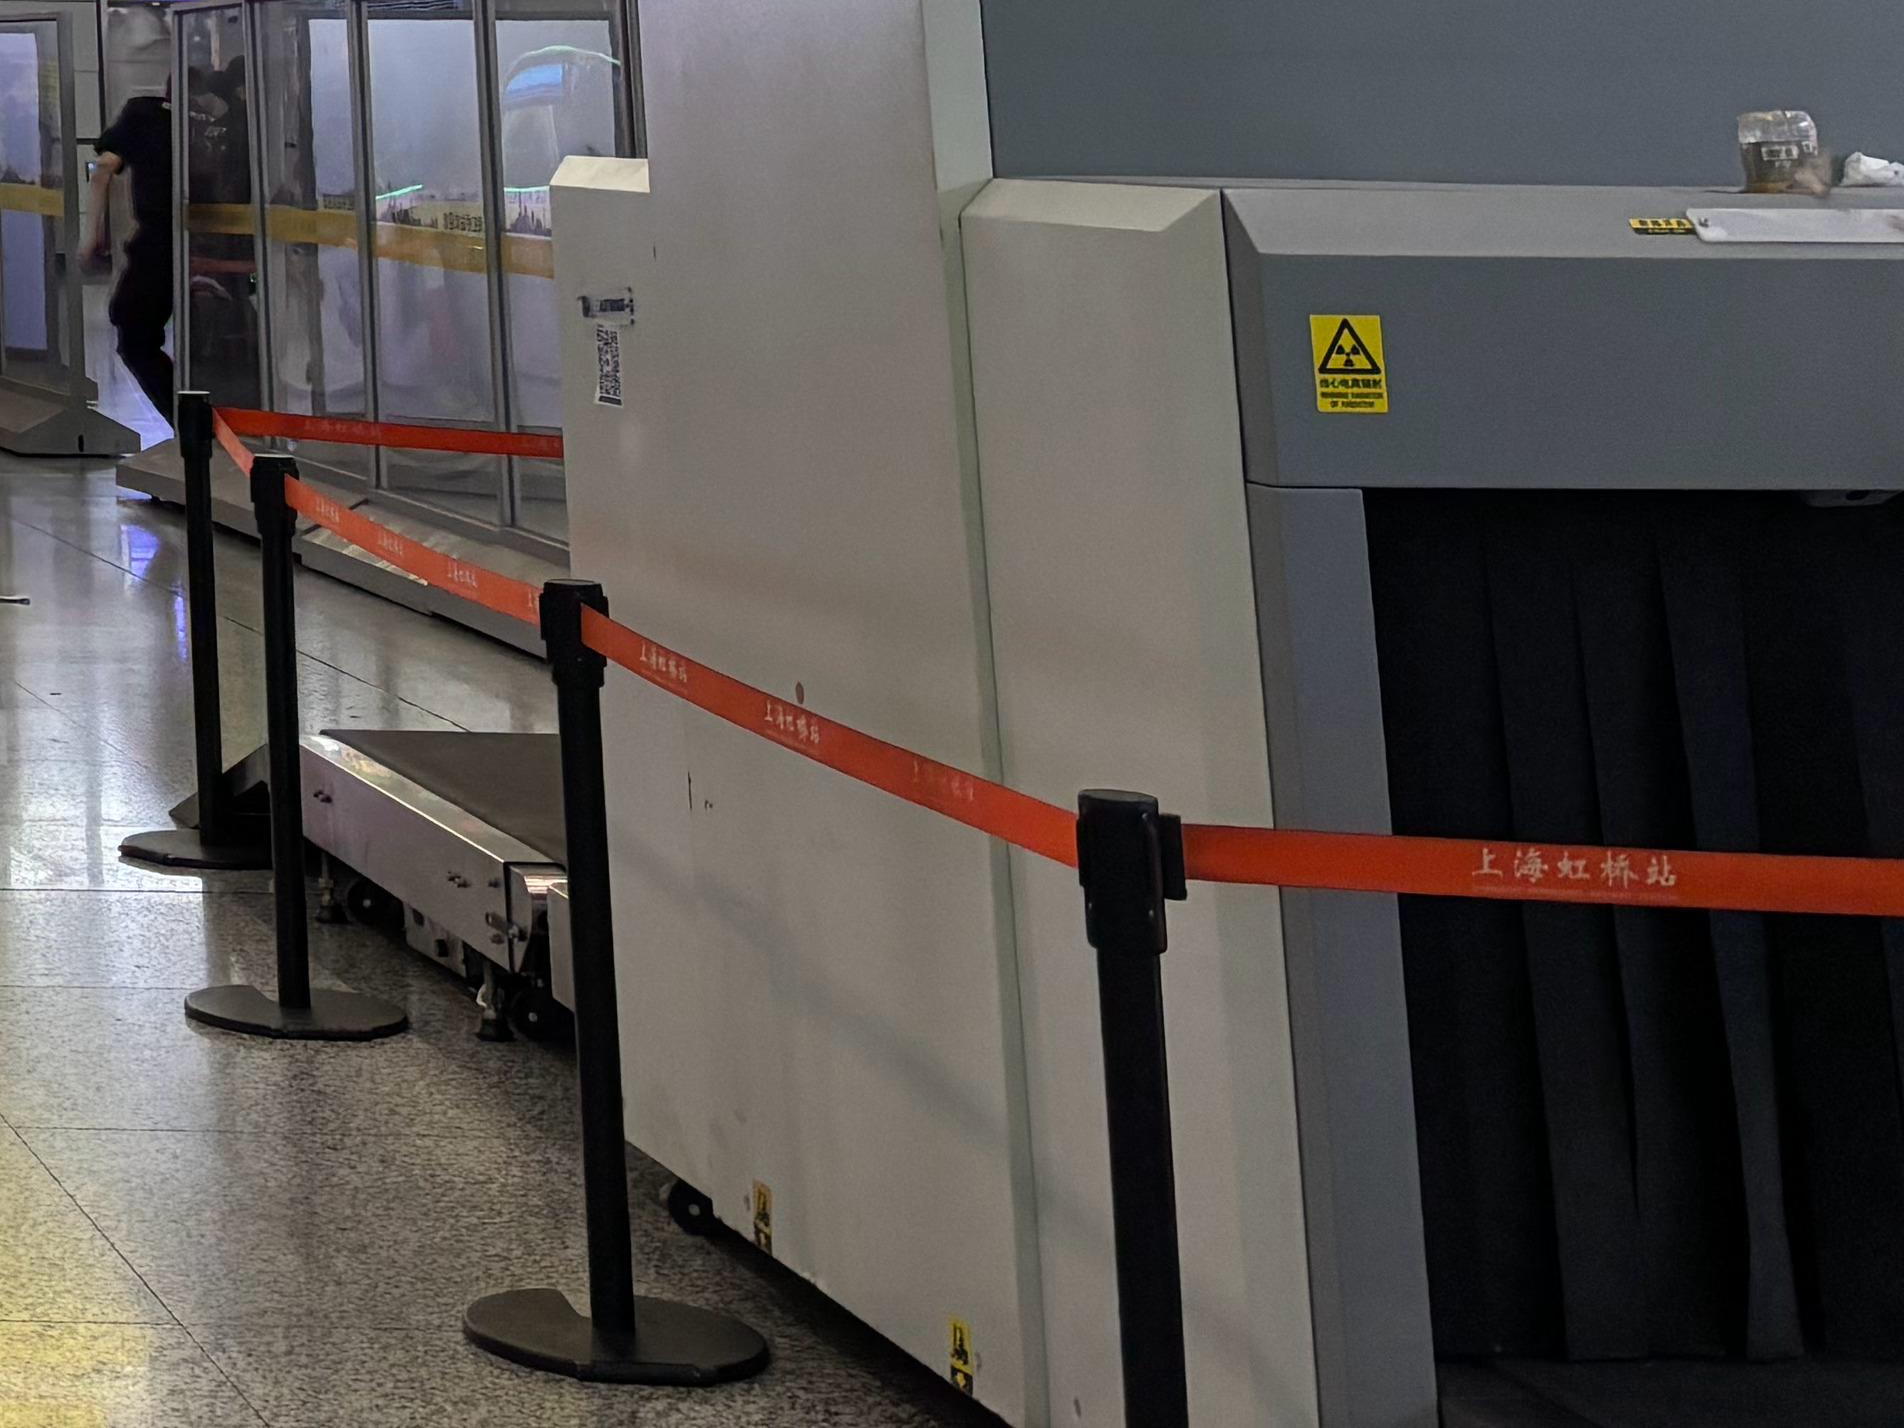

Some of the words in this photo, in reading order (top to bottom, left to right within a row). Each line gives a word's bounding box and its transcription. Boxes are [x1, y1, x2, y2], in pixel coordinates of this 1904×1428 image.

[1472, 845, 1678, 888] 上海虹桥站
